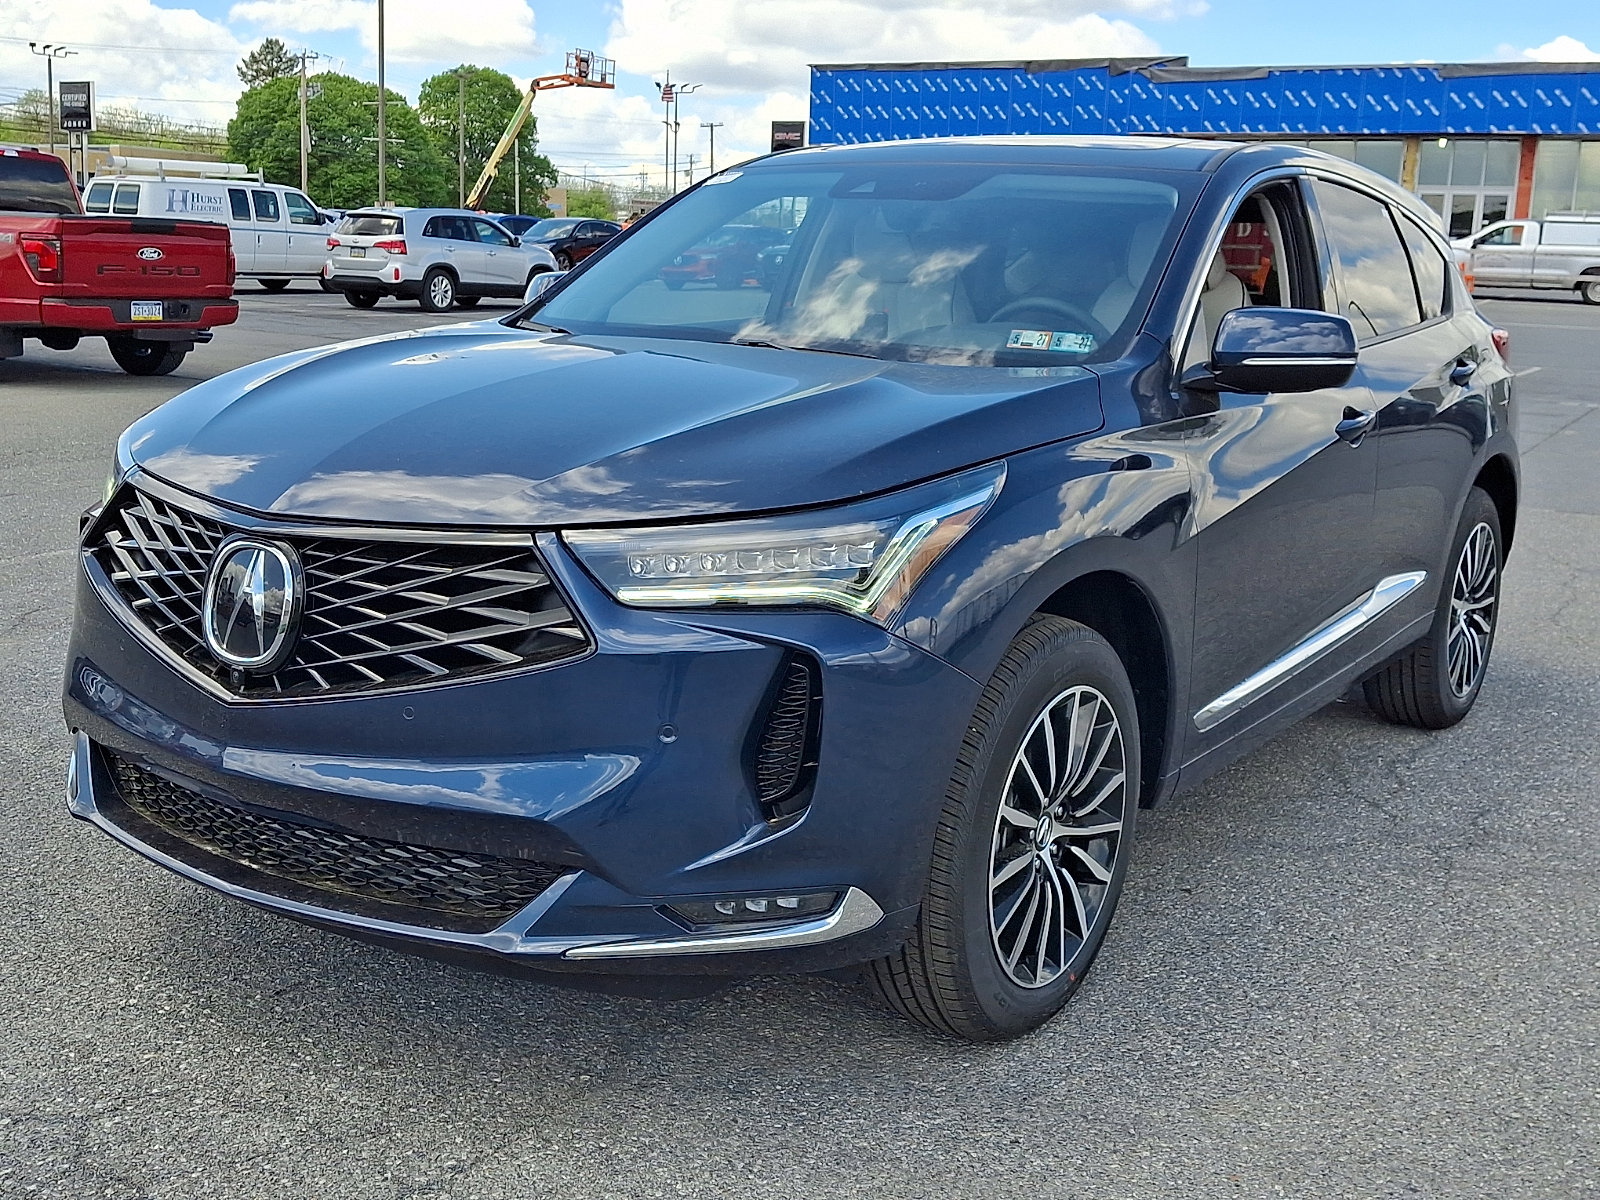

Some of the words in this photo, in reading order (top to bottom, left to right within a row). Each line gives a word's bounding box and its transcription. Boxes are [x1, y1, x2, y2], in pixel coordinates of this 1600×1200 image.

[61, 93, 87, 101] CERTIFIED
[774, 132, 801, 140] GMC
[142, 249, 158, 259] Ford
[97, 264, 200, 277] F-150
[1036, 333, 1048, 346] 27
